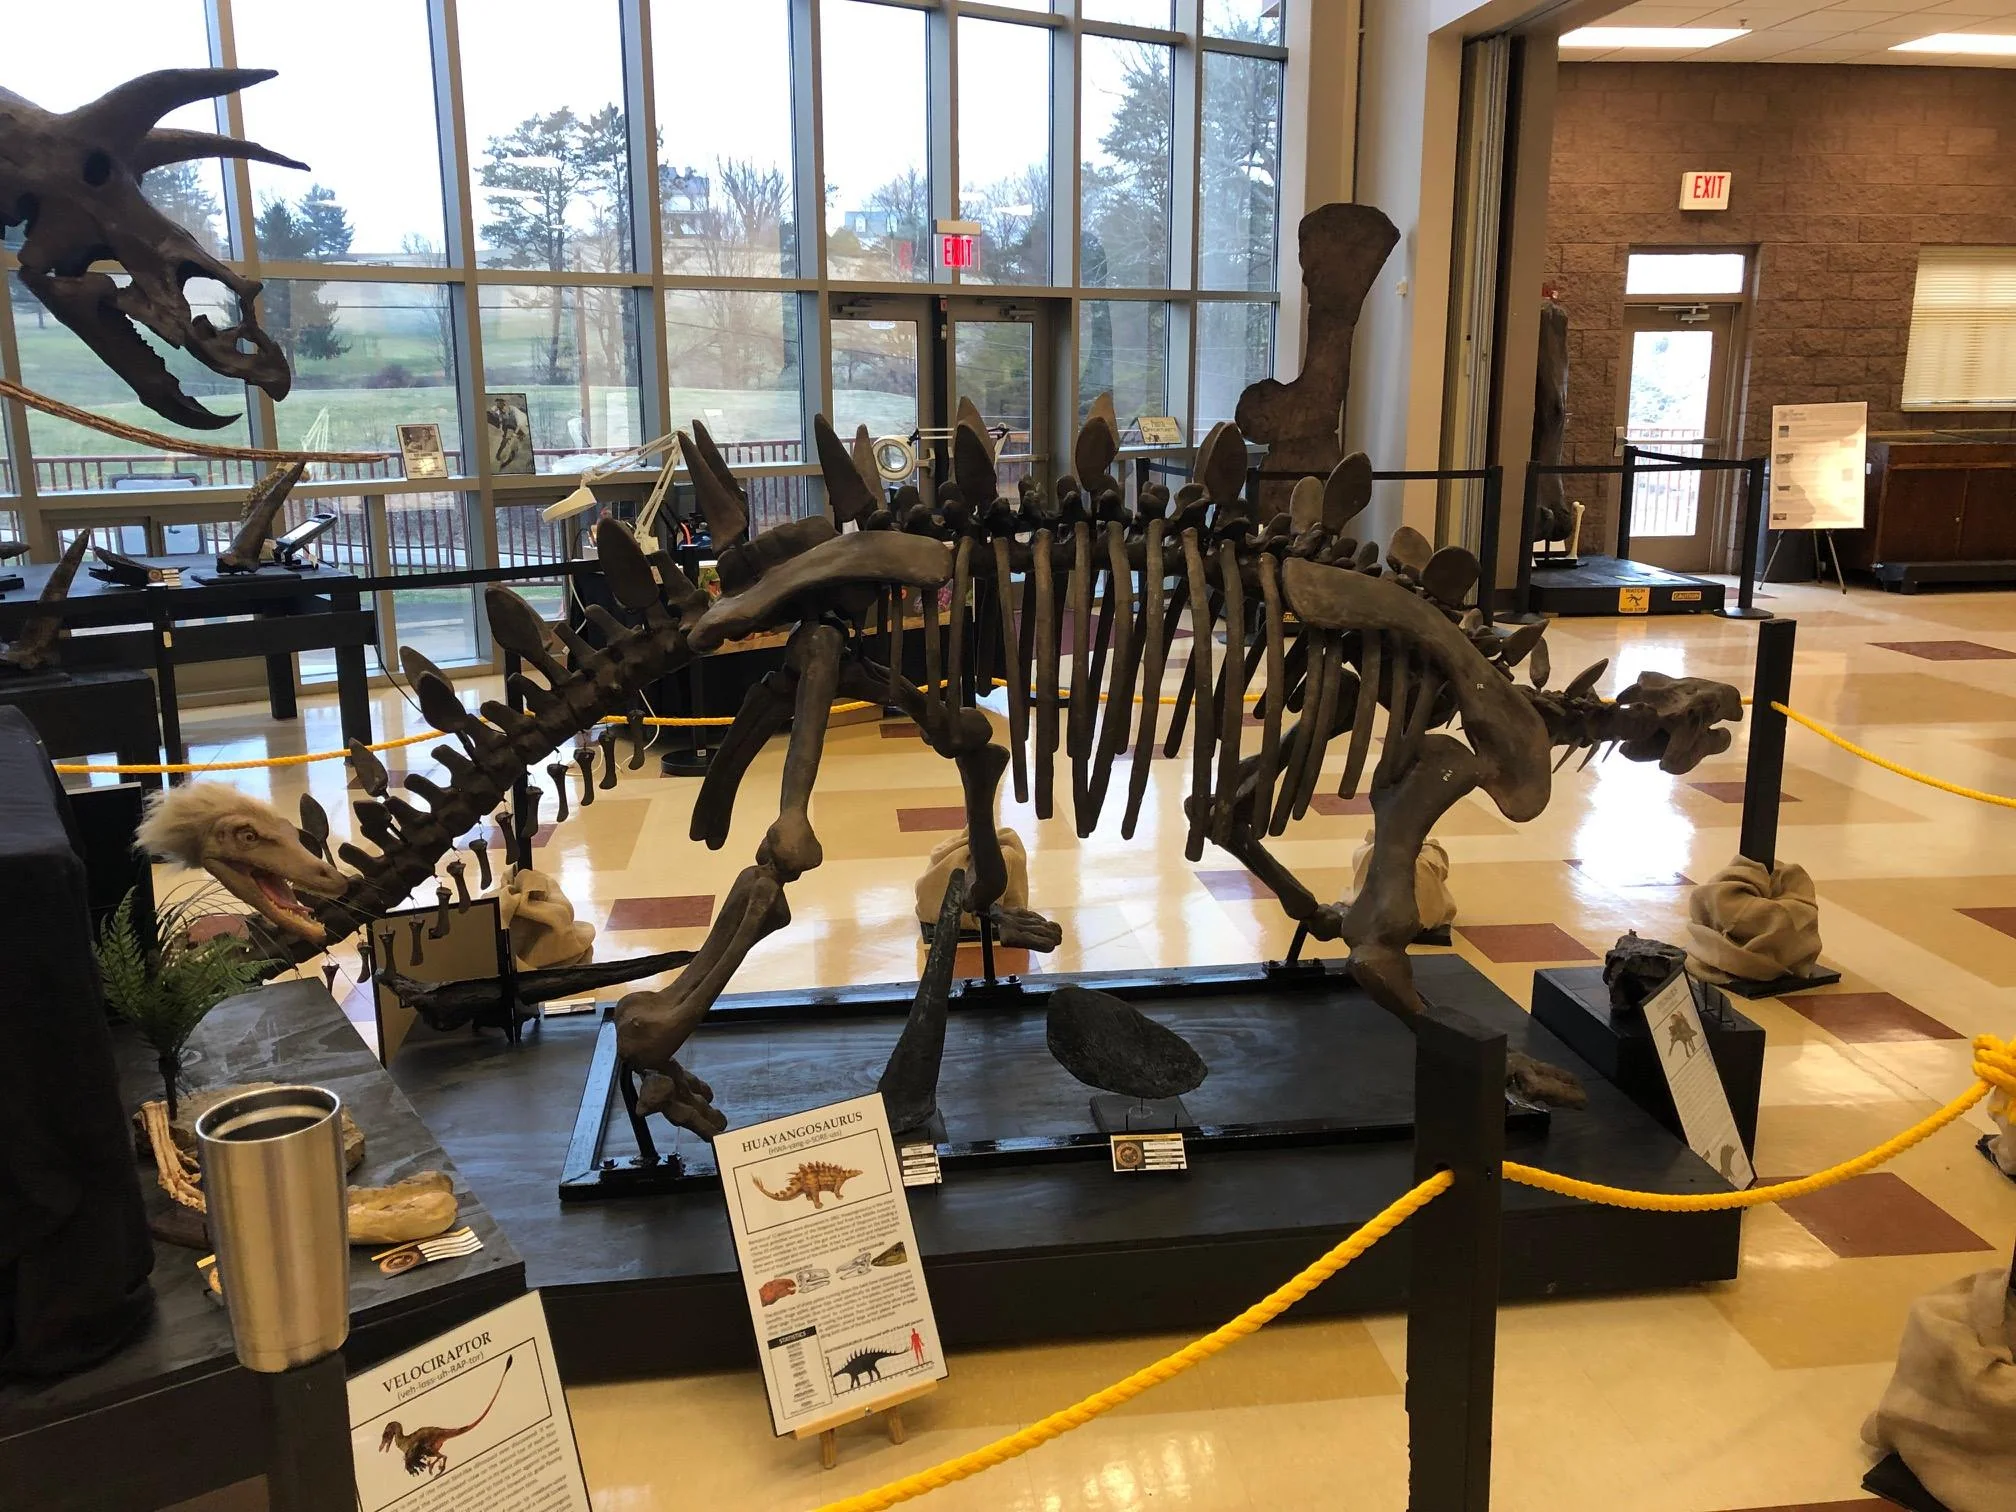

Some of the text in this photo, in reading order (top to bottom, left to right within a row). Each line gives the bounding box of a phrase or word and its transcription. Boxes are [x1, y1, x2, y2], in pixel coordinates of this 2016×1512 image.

[1693, 175, 1725, 198] EXIT
[943, 238, 972, 266] EXIT
[741, 1111, 863, 1152] HUAYANGOSAURUS
[779, 1330, 807, 1345] STATISTICS
[382, 1331, 492, 1393] VELOCIRAPTOR
